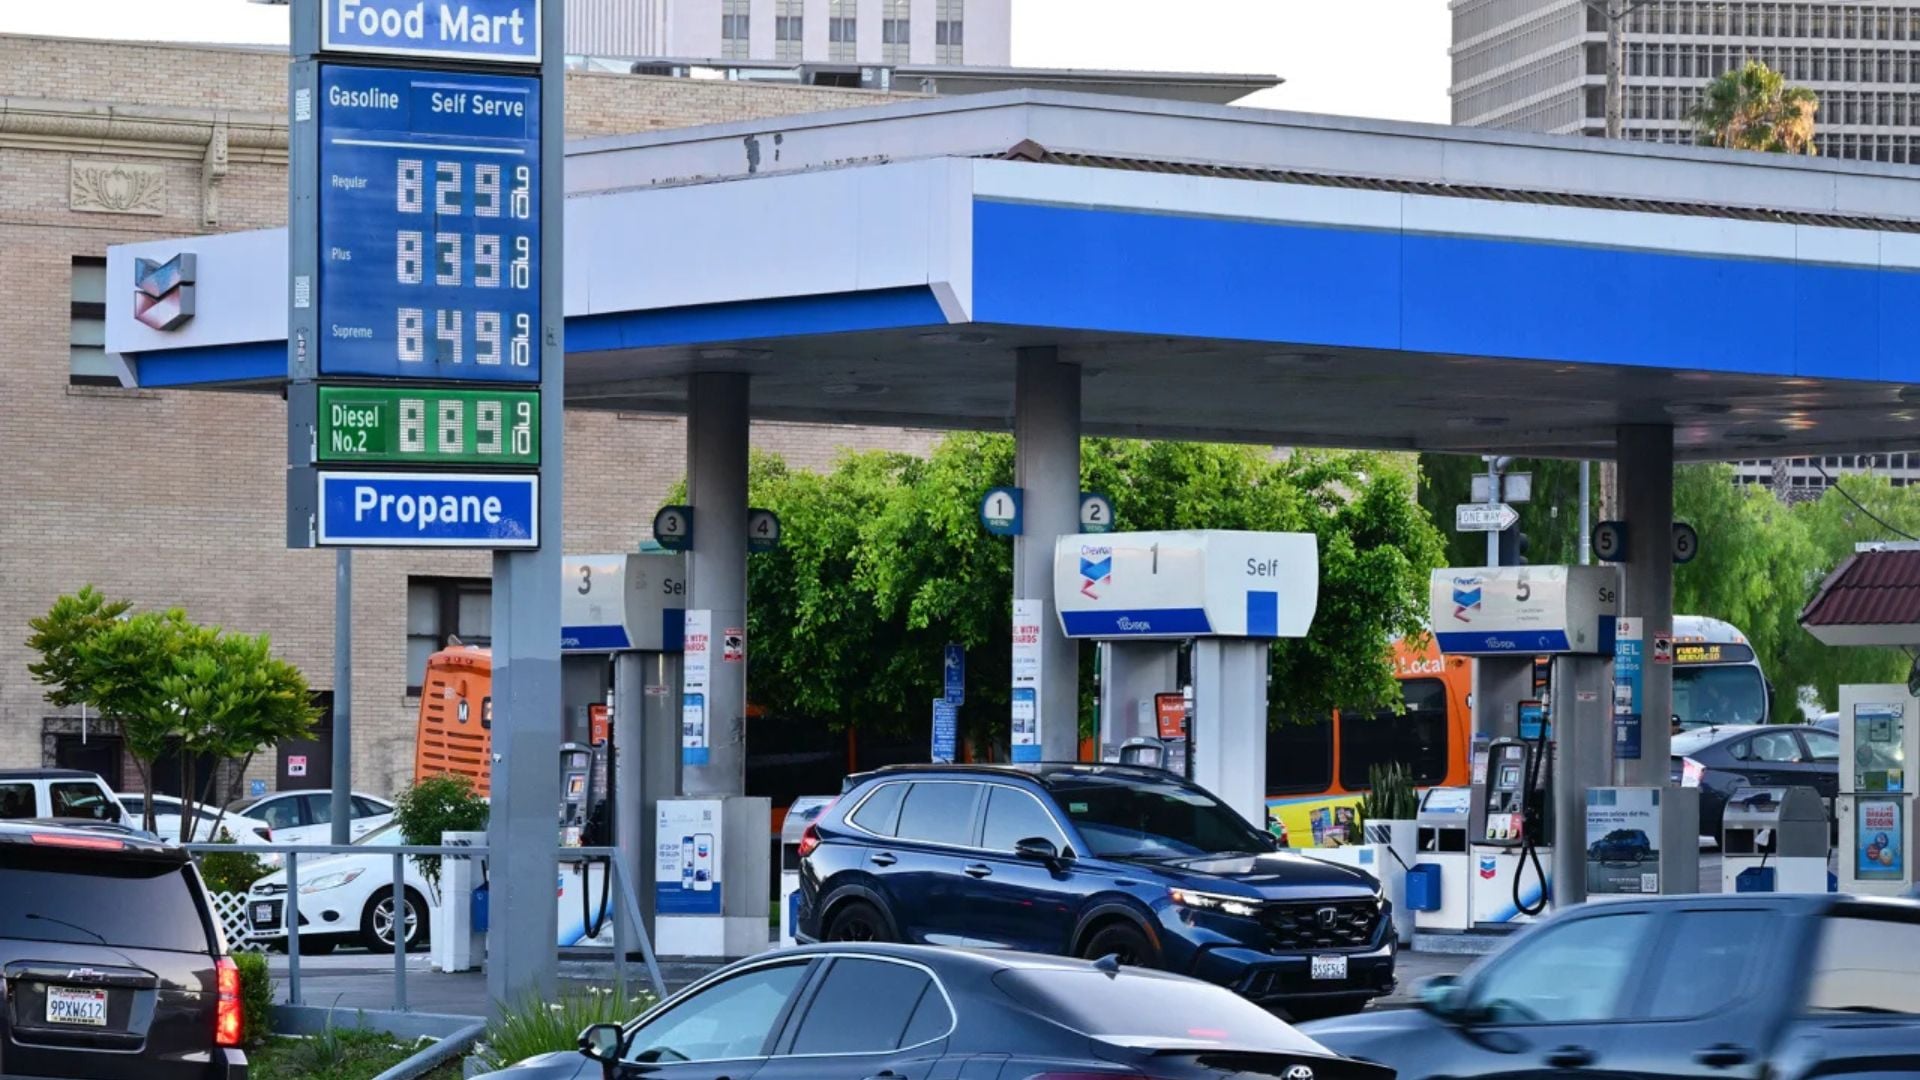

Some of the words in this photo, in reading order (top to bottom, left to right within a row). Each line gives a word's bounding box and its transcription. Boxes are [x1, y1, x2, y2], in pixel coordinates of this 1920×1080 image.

[338, 0, 424, 39] Food
[440, 6, 525, 45] Mart
[329, 85, 399, 109] Gasoline
[431, 92, 466, 114] Self
[472, 95, 524, 116] Serve
[332, 175, 368, 189] Regular
[397, 159, 500, 217] 829
[332, 248, 351, 260] Plus
[397, 231, 500, 287] 839
[332, 325, 373, 339] Supreme
[398, 308, 501, 365] 849
[332, 404, 378, 427] Diesel
[399, 399, 502, 454] 889
[332, 430, 367, 452] No.2
[354, 486, 502, 530] Propane
[996, 498, 1002, 516] 1
[1090, 504, 1101, 521] 2
[667, 516, 677, 532] 3
[1463, 512, 1481, 522] ONE
[1483, 511, 1501, 522] WAY
[757, 519, 769, 535] 4
[1601, 532, 1612, 550] 5
[1678, 535, 1688, 552] 6
[1150, 542, 1158, 575] 1
[1246, 558, 1279, 577] Self
[577, 565, 591, 595] 3
[663, 578, 686, 595] Sel
[1516, 571, 1531, 602] 5
[1598, 587, 1615, 603] Se
[1020, 624, 1040, 634] WITH
[1012, 635, 1038, 644] ARDS
[1616, 643, 1640, 656] UEL
[1677, 646, 1705, 654] FUERA
[1709, 645, 1721, 653] DE
[1400, 655, 1445, 674] Local
[1866, 818, 1894, 827] BEGIN
[51, 1000, 102, 1019] 9PXW612
